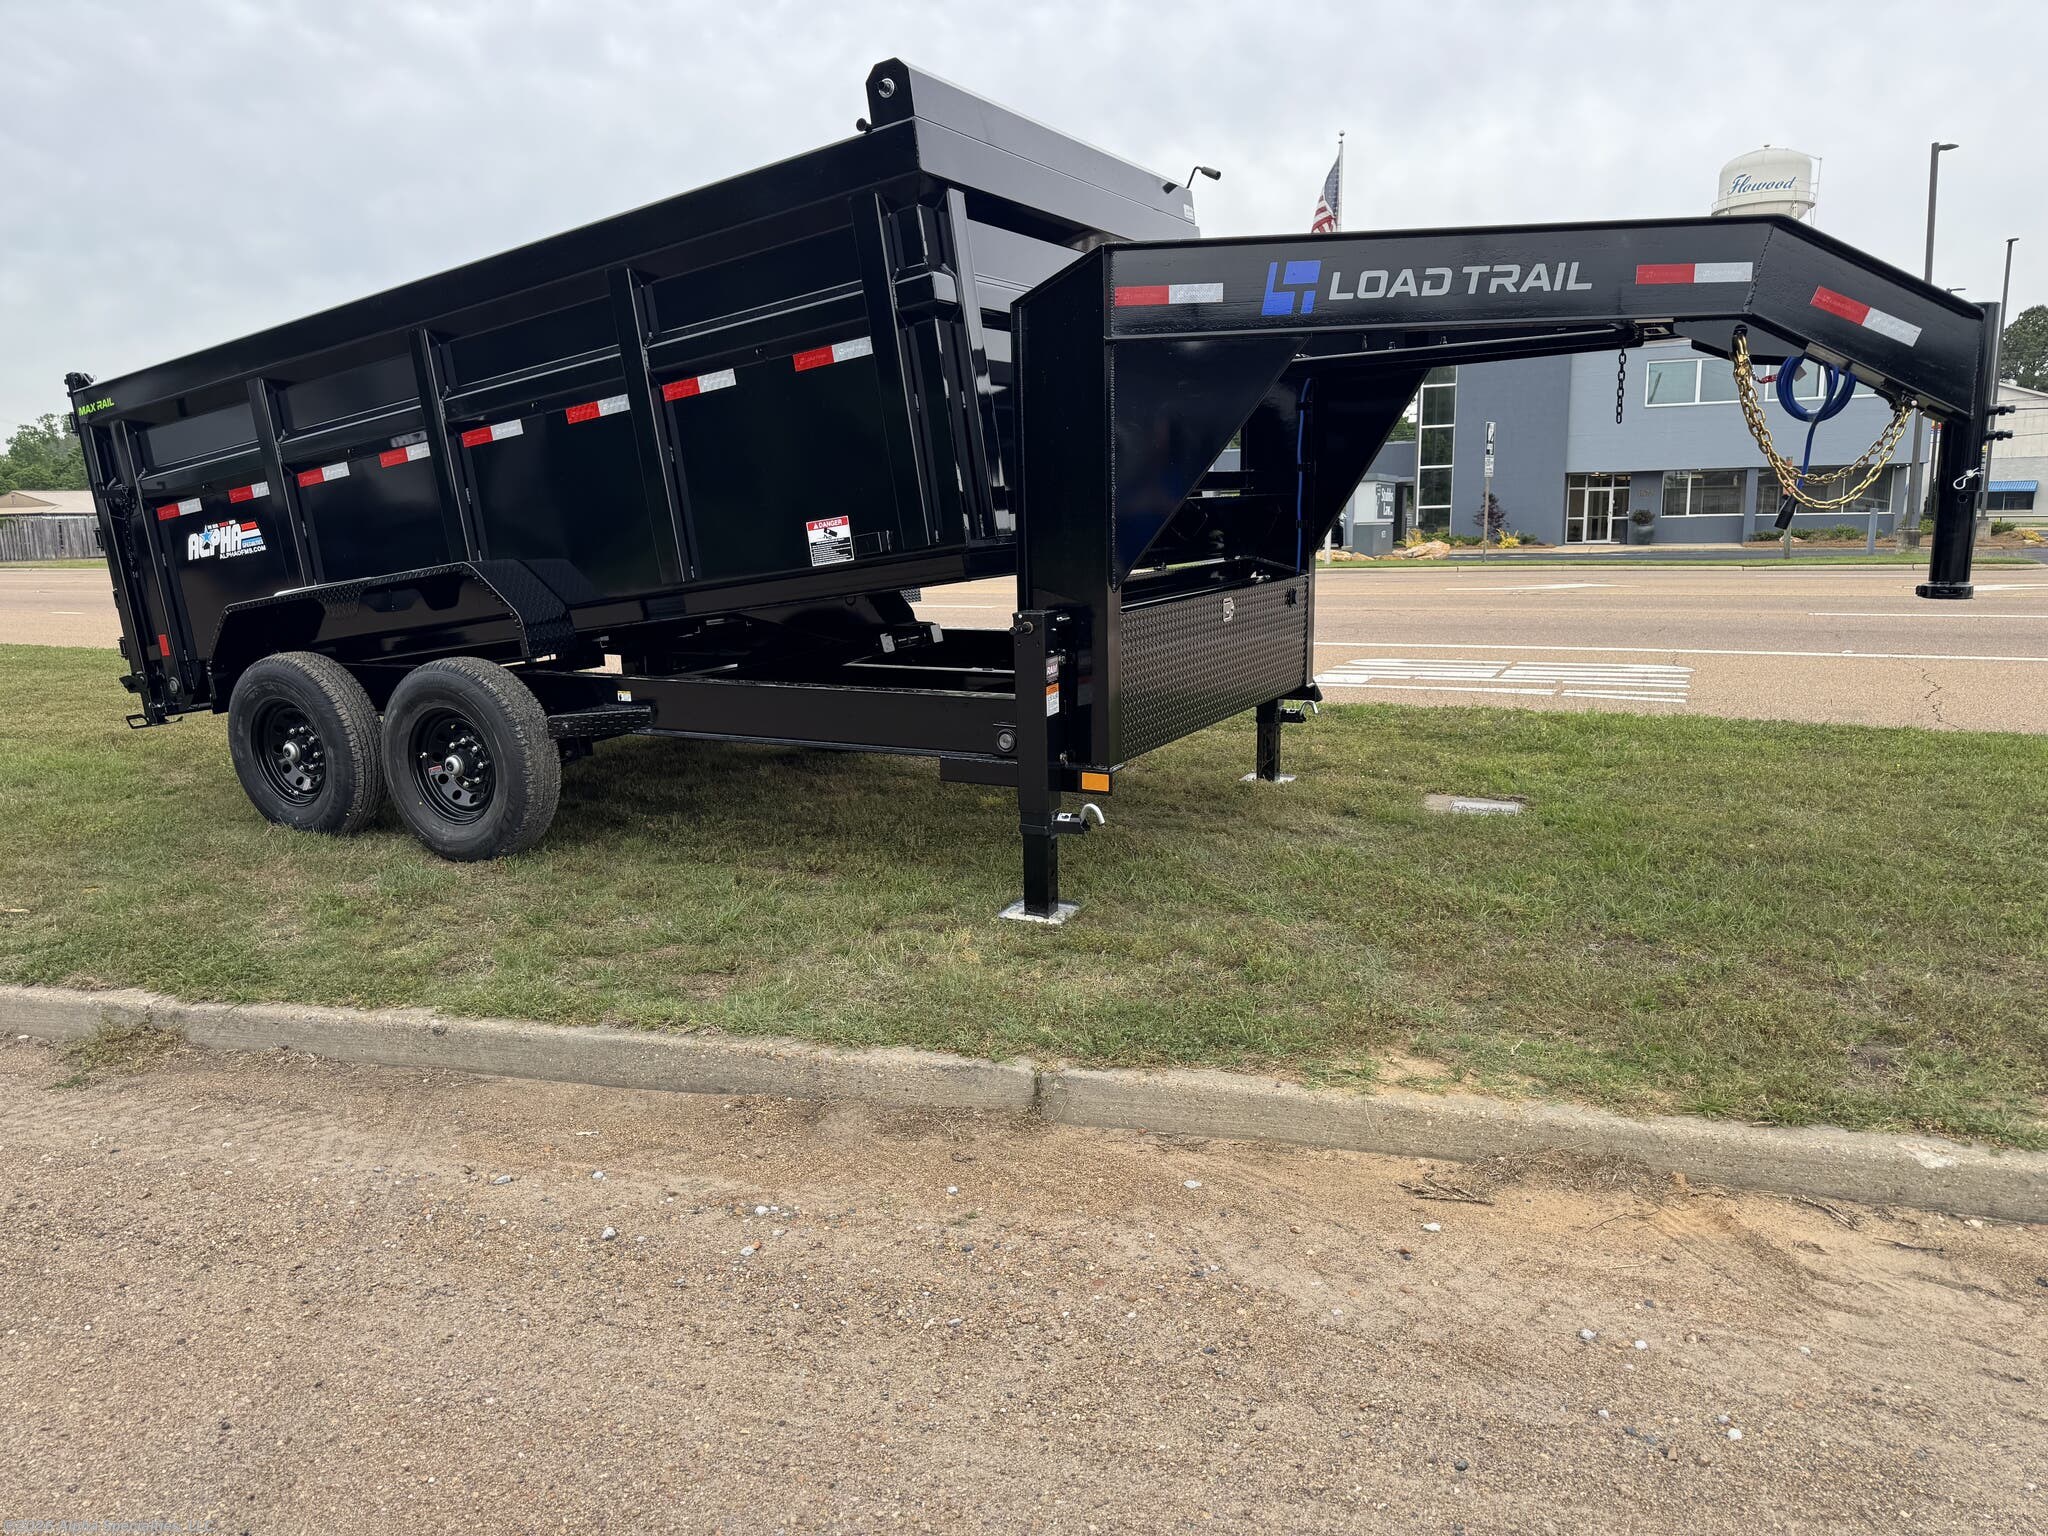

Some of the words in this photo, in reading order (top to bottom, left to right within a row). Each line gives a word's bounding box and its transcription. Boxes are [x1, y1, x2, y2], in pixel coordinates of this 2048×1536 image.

[1728, 173, 1797, 195] Flowood
[1328, 267, 1453, 301] LOAD
[1462, 261, 1593, 295] TRAIL
[78, 403, 96, 416] MAX
[97, 397, 115, 410] RAIL
[818, 519, 843, 529] DANGER
[188, 523, 242, 561] ALPHA
[219, 545, 267, 560] ALPHAOFMS.COM
